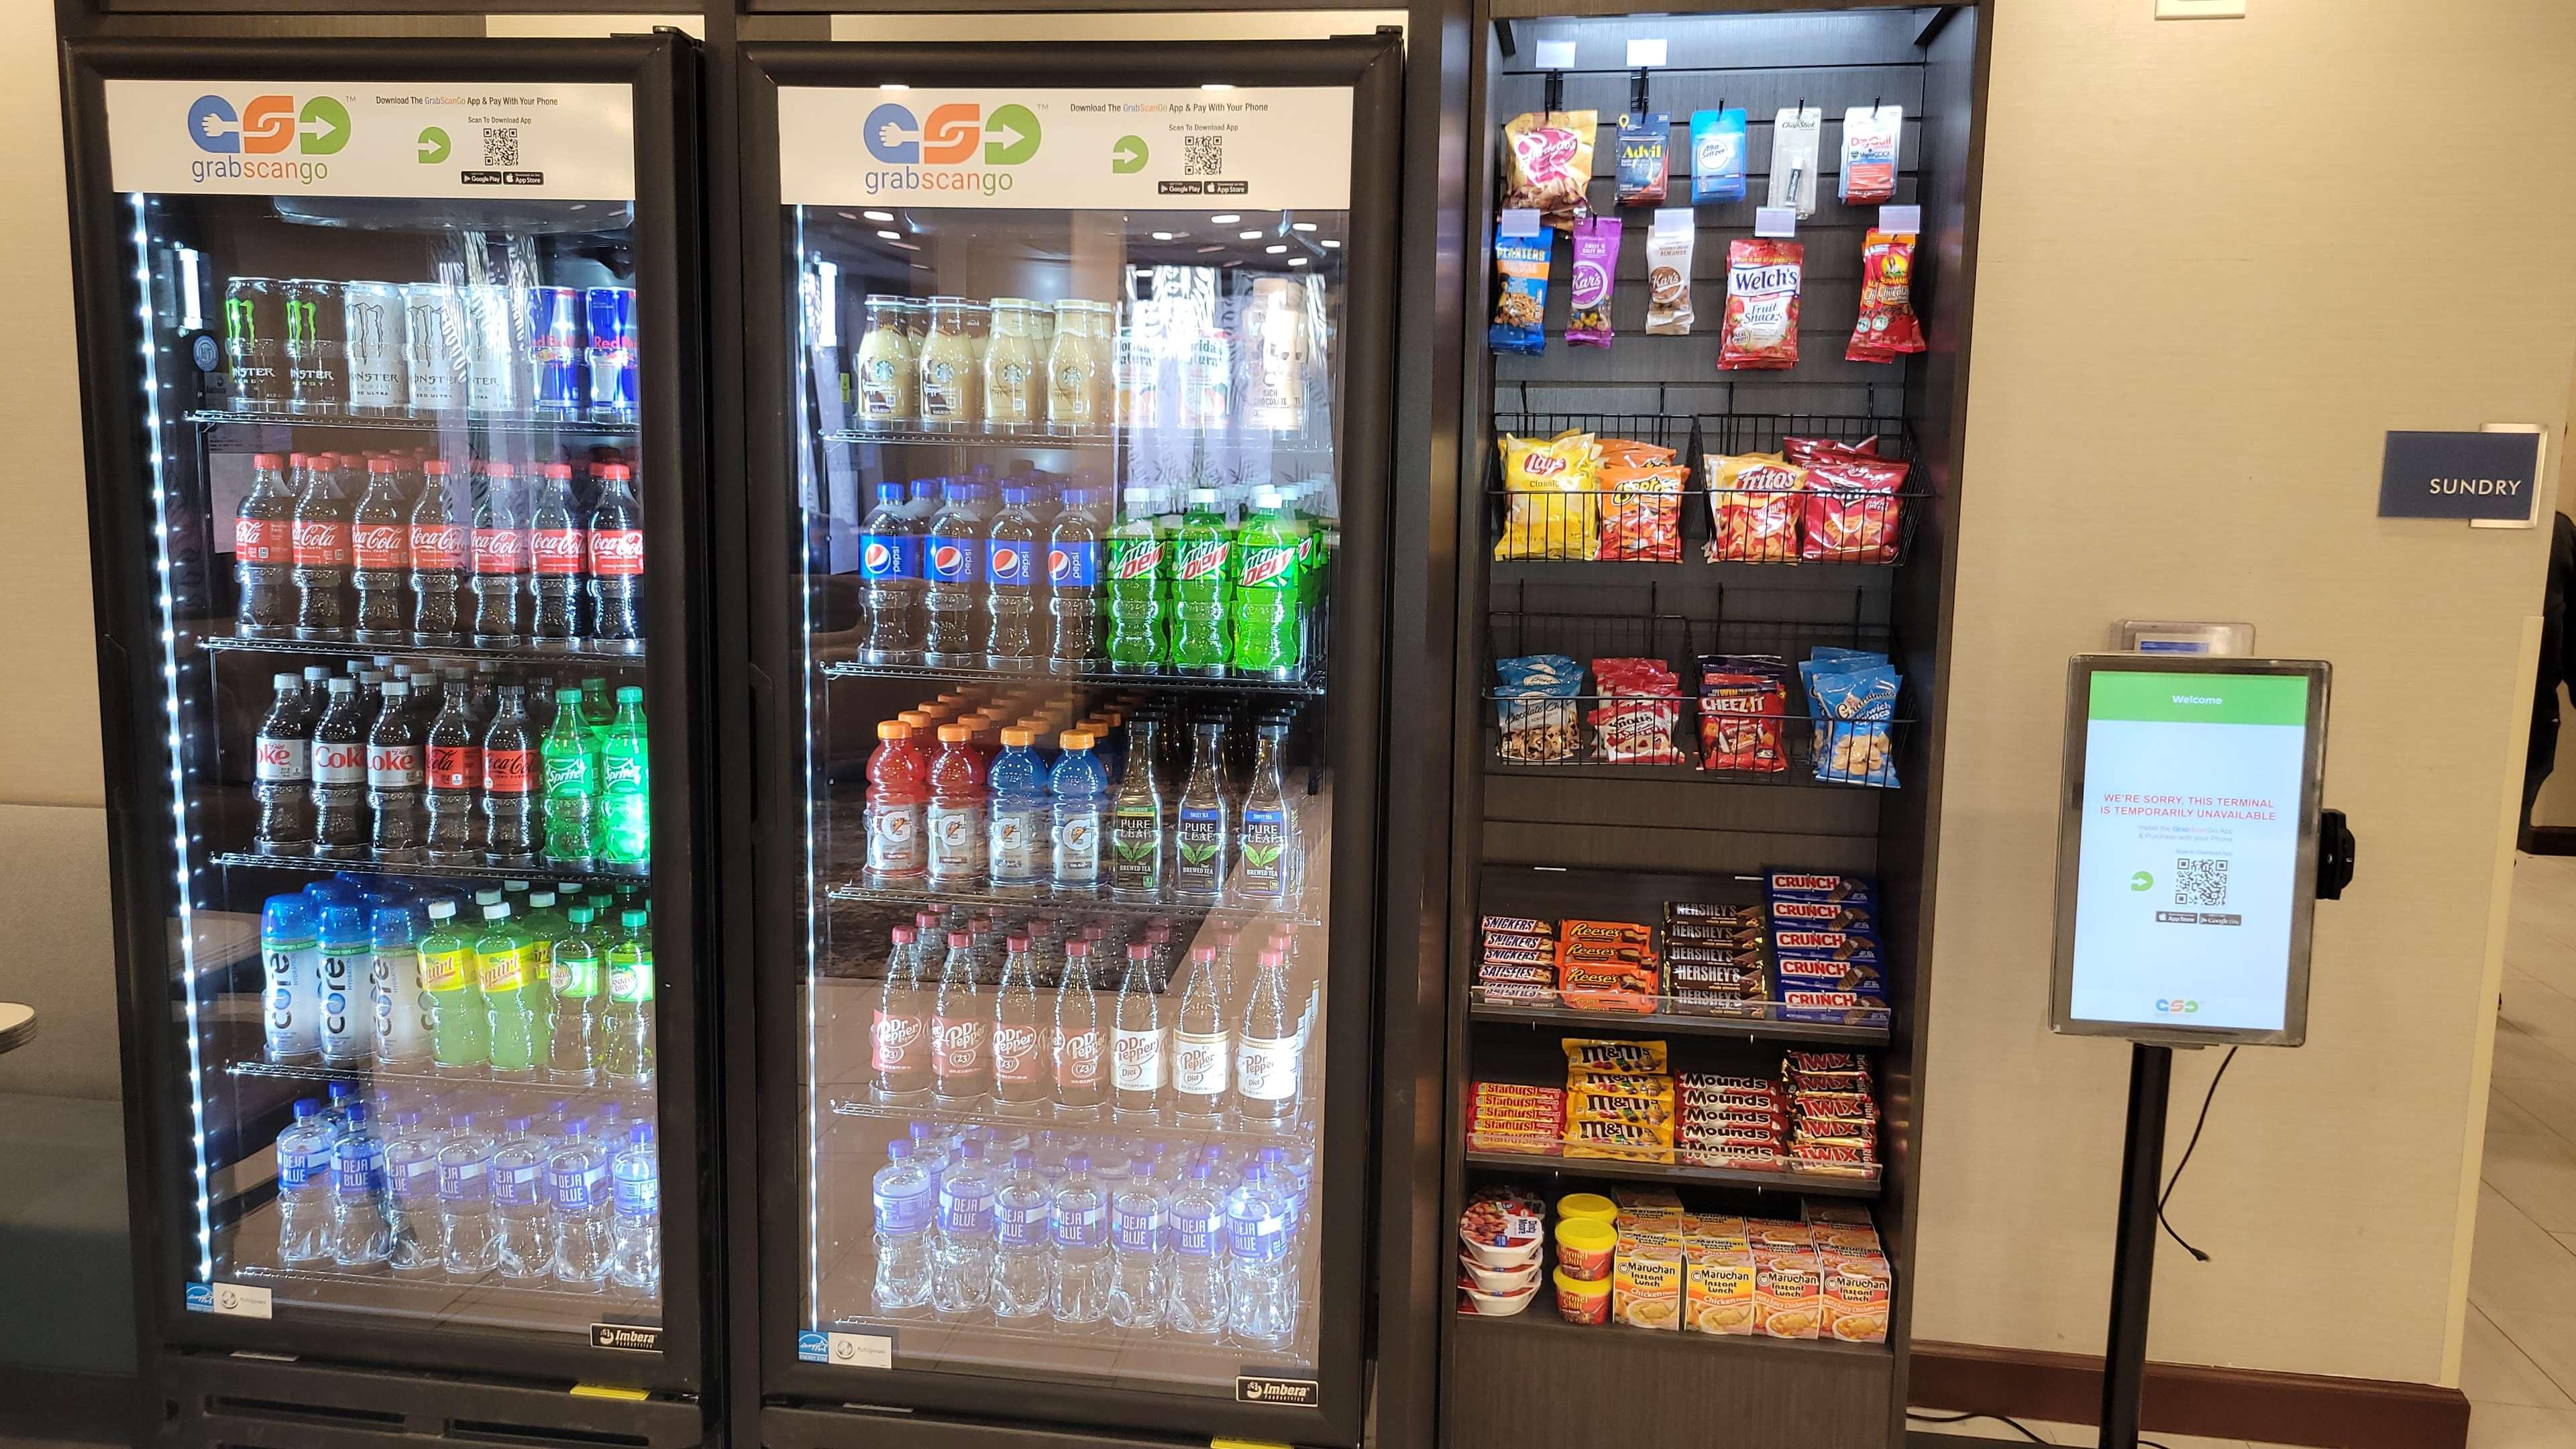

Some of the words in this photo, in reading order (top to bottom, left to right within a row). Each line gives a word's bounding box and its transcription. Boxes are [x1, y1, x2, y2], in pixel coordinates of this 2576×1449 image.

[376, 96, 409, 105] Download
[411, 97, 423, 105] The
[425, 97, 466, 105] GrabScanGo
[467, 97, 480, 107] App
[489, 97, 501, 107] Pay
[502, 97, 518, 105] With
[519, 98, 534, 106] Your
[537, 98, 558, 106] Phone
[1070, 103, 1106, 113] Download
[1108, 104, 1121, 113] The
[1123, 104, 1167, 113] GrabScanGo
[1169, 104, 1183, 113] App
[1185, 104, 1191, 112] &
[1193, 104, 1207, 113] Pay
[1208, 103, 1225, 112] With
[1226, 103, 1242, 112] Your
[1245, 103, 1269, 112] Phone
[1226, 124, 1238, 132] App
[1782, 121, 1815, 129] ChapStick
[1622, 145, 1662, 158] Advil
[1702, 148, 1725, 159] Seltzer
[192, 155, 327, 185] grabscango
[865, 166, 1013, 197] grabscango
[1169, 186, 1188, 194] Google
[1572, 270, 1601, 290] Kar's
[1652, 272, 1679, 289] Kar's
[1736, 269, 1798, 291] Welch's
[1752, 303, 1777, 315] Fruit
[594, 335, 619, 348] Red
[1525, 454, 1567, 475] Lay's
[1738, 463, 1796, 490] Fritos
[2429, 478, 2522, 496] SUNDRY
[530, 531, 587, 555] Coca-Cola
[891, 545, 900, 573] pepsi
[965, 548, 973, 576] pepsi
[1021, 551, 1030, 578] pepsi
[1073, 551, 1081, 579] pepsi
[1701, 696, 1765, 713] CHEEZ-IT
[1836, 690, 1896, 720] Grandma's
[2171, 694, 2222, 705] Welcome
[547, 766, 585, 784] Sprite
[2104, 794, 2140, 803] WE'RE
[2189, 796, 2213, 806] THIS
[2216, 797, 2275, 808] TERMINAL
[2100, 806, 2111, 815] IS
[2114, 806, 2194, 818] TEMPORARILY
[2197, 808, 2276, 820] UNAVAILABLE
[1120, 819, 1151, 829] PURE
[1185, 822, 1214, 833] PURE
[1248, 824, 1278, 834] PURE
[1120, 828, 1152, 839] LEAF
[1185, 833, 1214, 842] LEAF
[1248, 834, 1279, 843] LEAF
[2172, 826, 2218, 835] GrabScanGo
[2220, 828, 2233, 837] App
[2210, 836, 2233, 844] Phone
[1183, 866, 1204, 874] BREWED
[1204, 867, 1214, 875] TEA
[1774, 875, 1837, 890] CRUNCH
[1776, 903, 1839, 917] CRUNCH
[1483, 916, 1535, 931] SNICKERS
[1570, 923, 1622, 938] Reese's
[1672, 925, 1733, 940] HERSHEY'S
[1488, 933, 1539, 949] SNICKERS
[1778, 933, 1845, 947] CRUNCH
[1485, 949, 1537, 961] SNICKERS
[1566, 943, 1618, 957] Reese's
[1481, 965, 1534, 979] SATISFIES
[1678, 965, 1741, 983] HERSHEY'S
[1782, 961, 1849, 975] CRUNCH
[1567, 969, 1619, 983] Reese's
[326, 957, 346, 1035] core
[964, 1020, 979, 1033] Dr
[1008, 1027, 1024, 1040] Dr
[946, 1024, 987, 1049] Pepper
[1116, 1040, 1157, 1062] Pepper
[1128, 1037, 1145, 1052] Dr
[1792, 1053, 1856, 1071] TWIX
[1121, 1067, 1137, 1077] Diet
[1187, 1074, 1200, 1082] Diet
[1248, 1078, 1260, 1086] Diet
[1684, 1073, 1768, 1090] Mounds
[1684, 1090, 1771, 1108] Mounds
[1796, 1097, 1863, 1118] TWIX
[1684, 1108, 1771, 1125] Mounds
[1684, 1124, 1770, 1140] Mounds
[1795, 1120, 1858, 1138] TWIX
[343, 1160, 368, 1173] DEJA
[343, 1173, 369, 1187] BLUE
[557, 1173, 582, 1188] DEJA
[559, 1187, 584, 1202] BLUE
[954, 1197, 978, 1212] DEJA
[953, 1213, 977, 1227] BLUE
[1123, 1215, 1147, 1230] DEJA
[1182, 1218, 1206, 1233] DEJA
[1518, 1218, 1526, 1235] Moore
[1526, 1220, 1538, 1237] Dinty
[1123, 1230, 1146, 1246] BLUE
[1183, 1234, 1207, 1248] BLUE
[1559, 1244, 1589, 1261] Hormel
[1564, 1254, 1583, 1267] Chili
[1627, 1262, 1676, 1275] Maruchan
[1701, 1269, 1750, 1281] Maruchan
[1631, 1272, 1664, 1282] Instant
[1634, 1278, 1660, 1287] Lunch
[1705, 1279, 1737, 1288] Instant
[1768, 1273, 1817, 1284] Maruchan
[1836, 1278, 1886, 1289] Maruchan
[1631, 1287, 1663, 1297] Chicken
[1707, 1285, 1733, 1294] Lunch
[1772, 1282, 1805, 1291] Instant
[1775, 1289, 1801, 1297] Lunch
[1840, 1287, 1873, 1296] Instant
[1703, 1295, 1737, 1305] Chicken
[1843, 1294, 1869, 1302] Lunch
[614, 1330, 655, 1344] Imbera
[1263, 1383, 1307, 1397] Imbera
